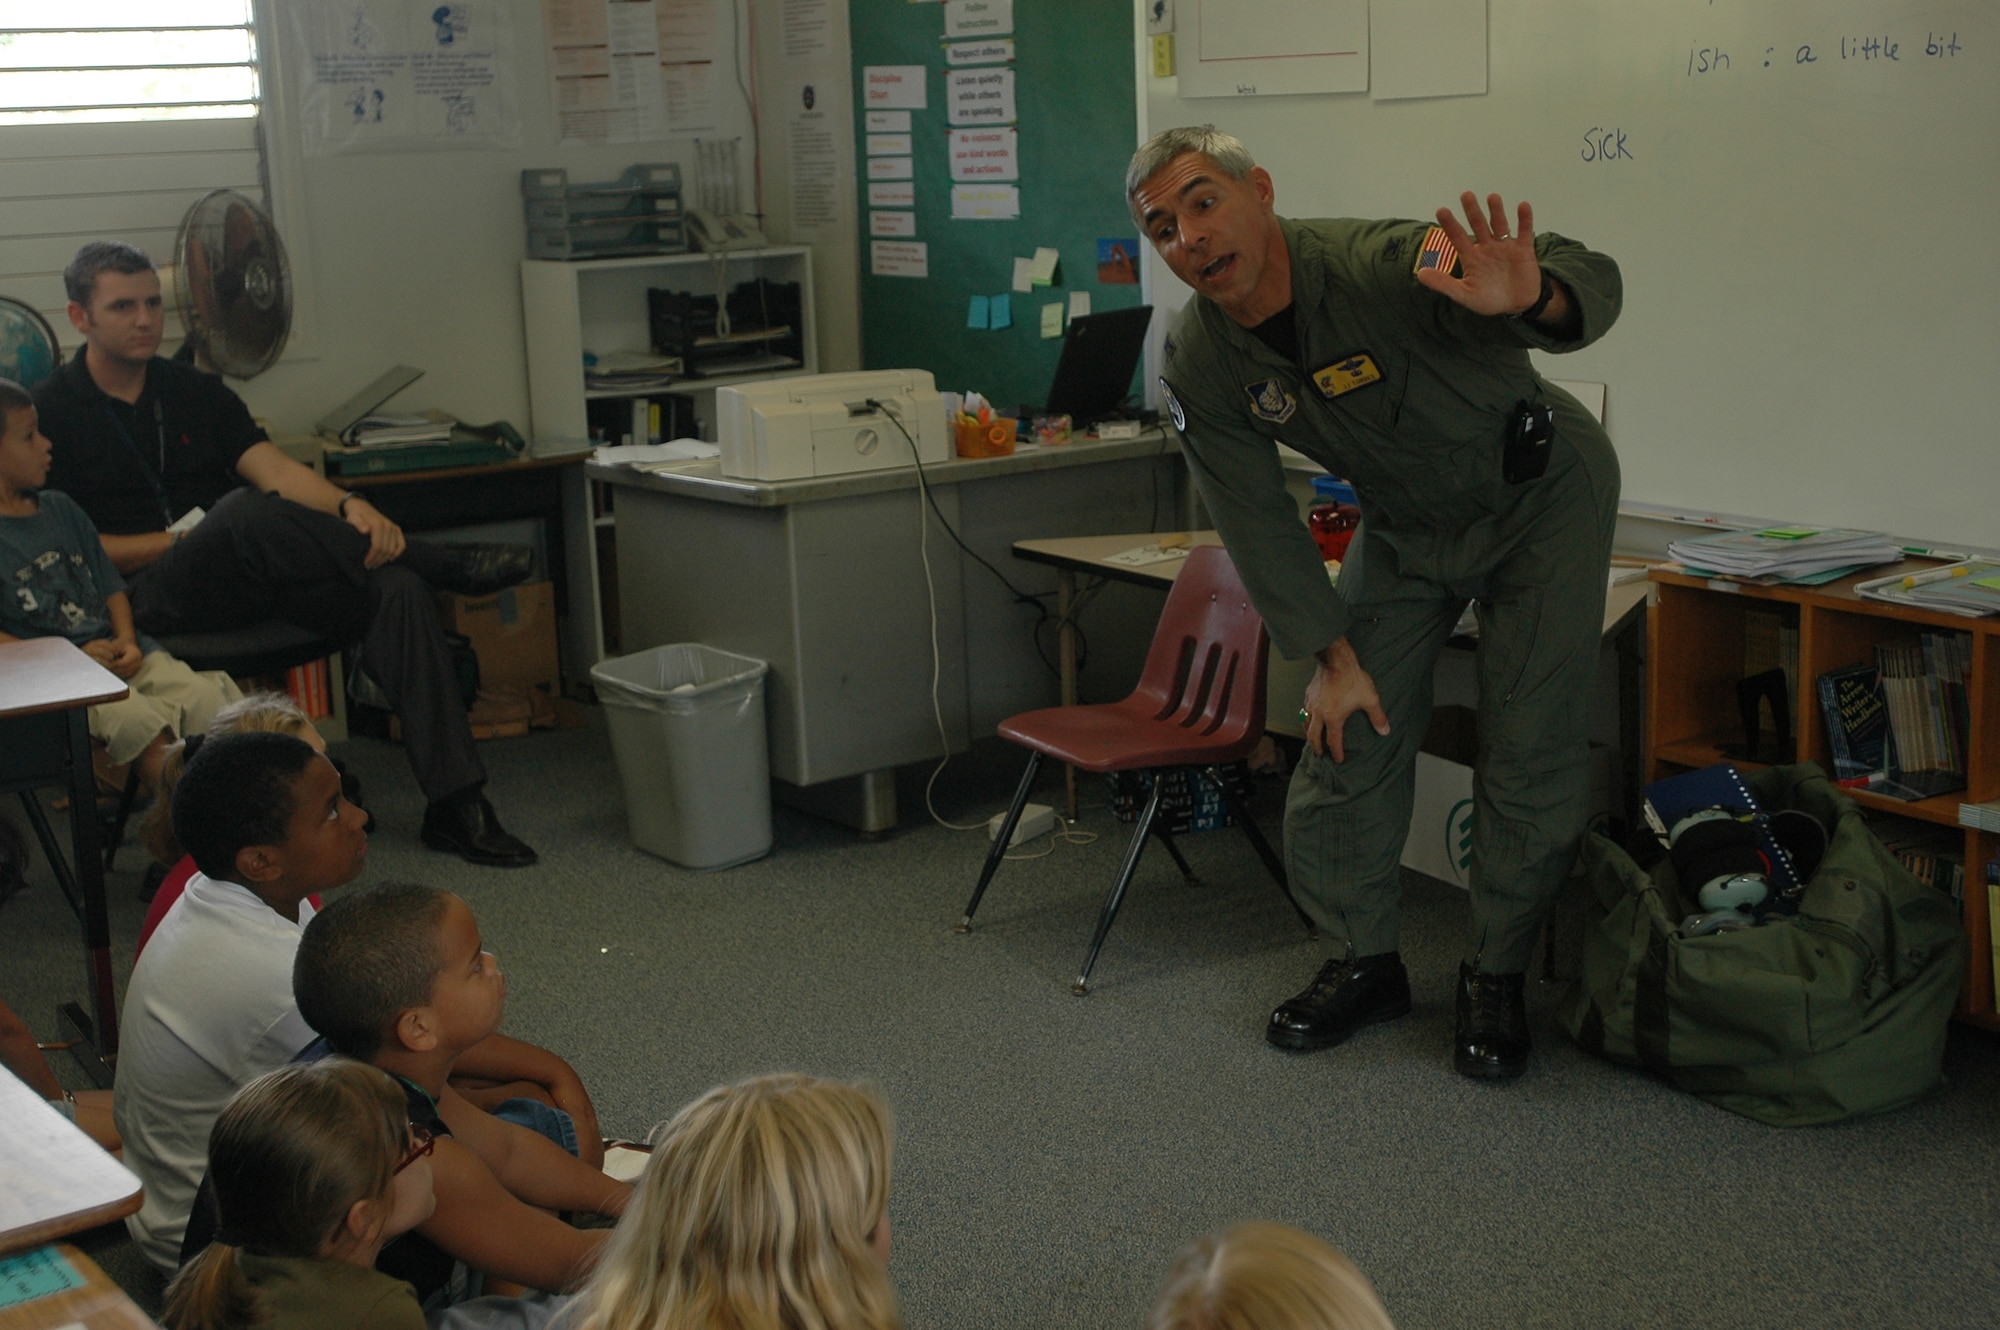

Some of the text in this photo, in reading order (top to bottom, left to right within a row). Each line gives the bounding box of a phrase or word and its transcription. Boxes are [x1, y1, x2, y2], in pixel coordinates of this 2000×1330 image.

[952, 46, 1006, 59] Respect others
[1687, 39, 1730, 76] ish
[1796, 45, 1818, 64] a
[1841, 36, 1900, 60] little
[1925, 32, 1962, 58] bit
[955, 73, 1003, 86] Listen quietly
[958, 90, 1001, 101] while others
[971, 106, 1003, 117] speaking
[1581, 127, 1633, 162] Sick
[1840, 680, 1856, 692] The
[1840, 682, 1866, 706] Arrow
[1844, 698, 1883, 734] Handbook
